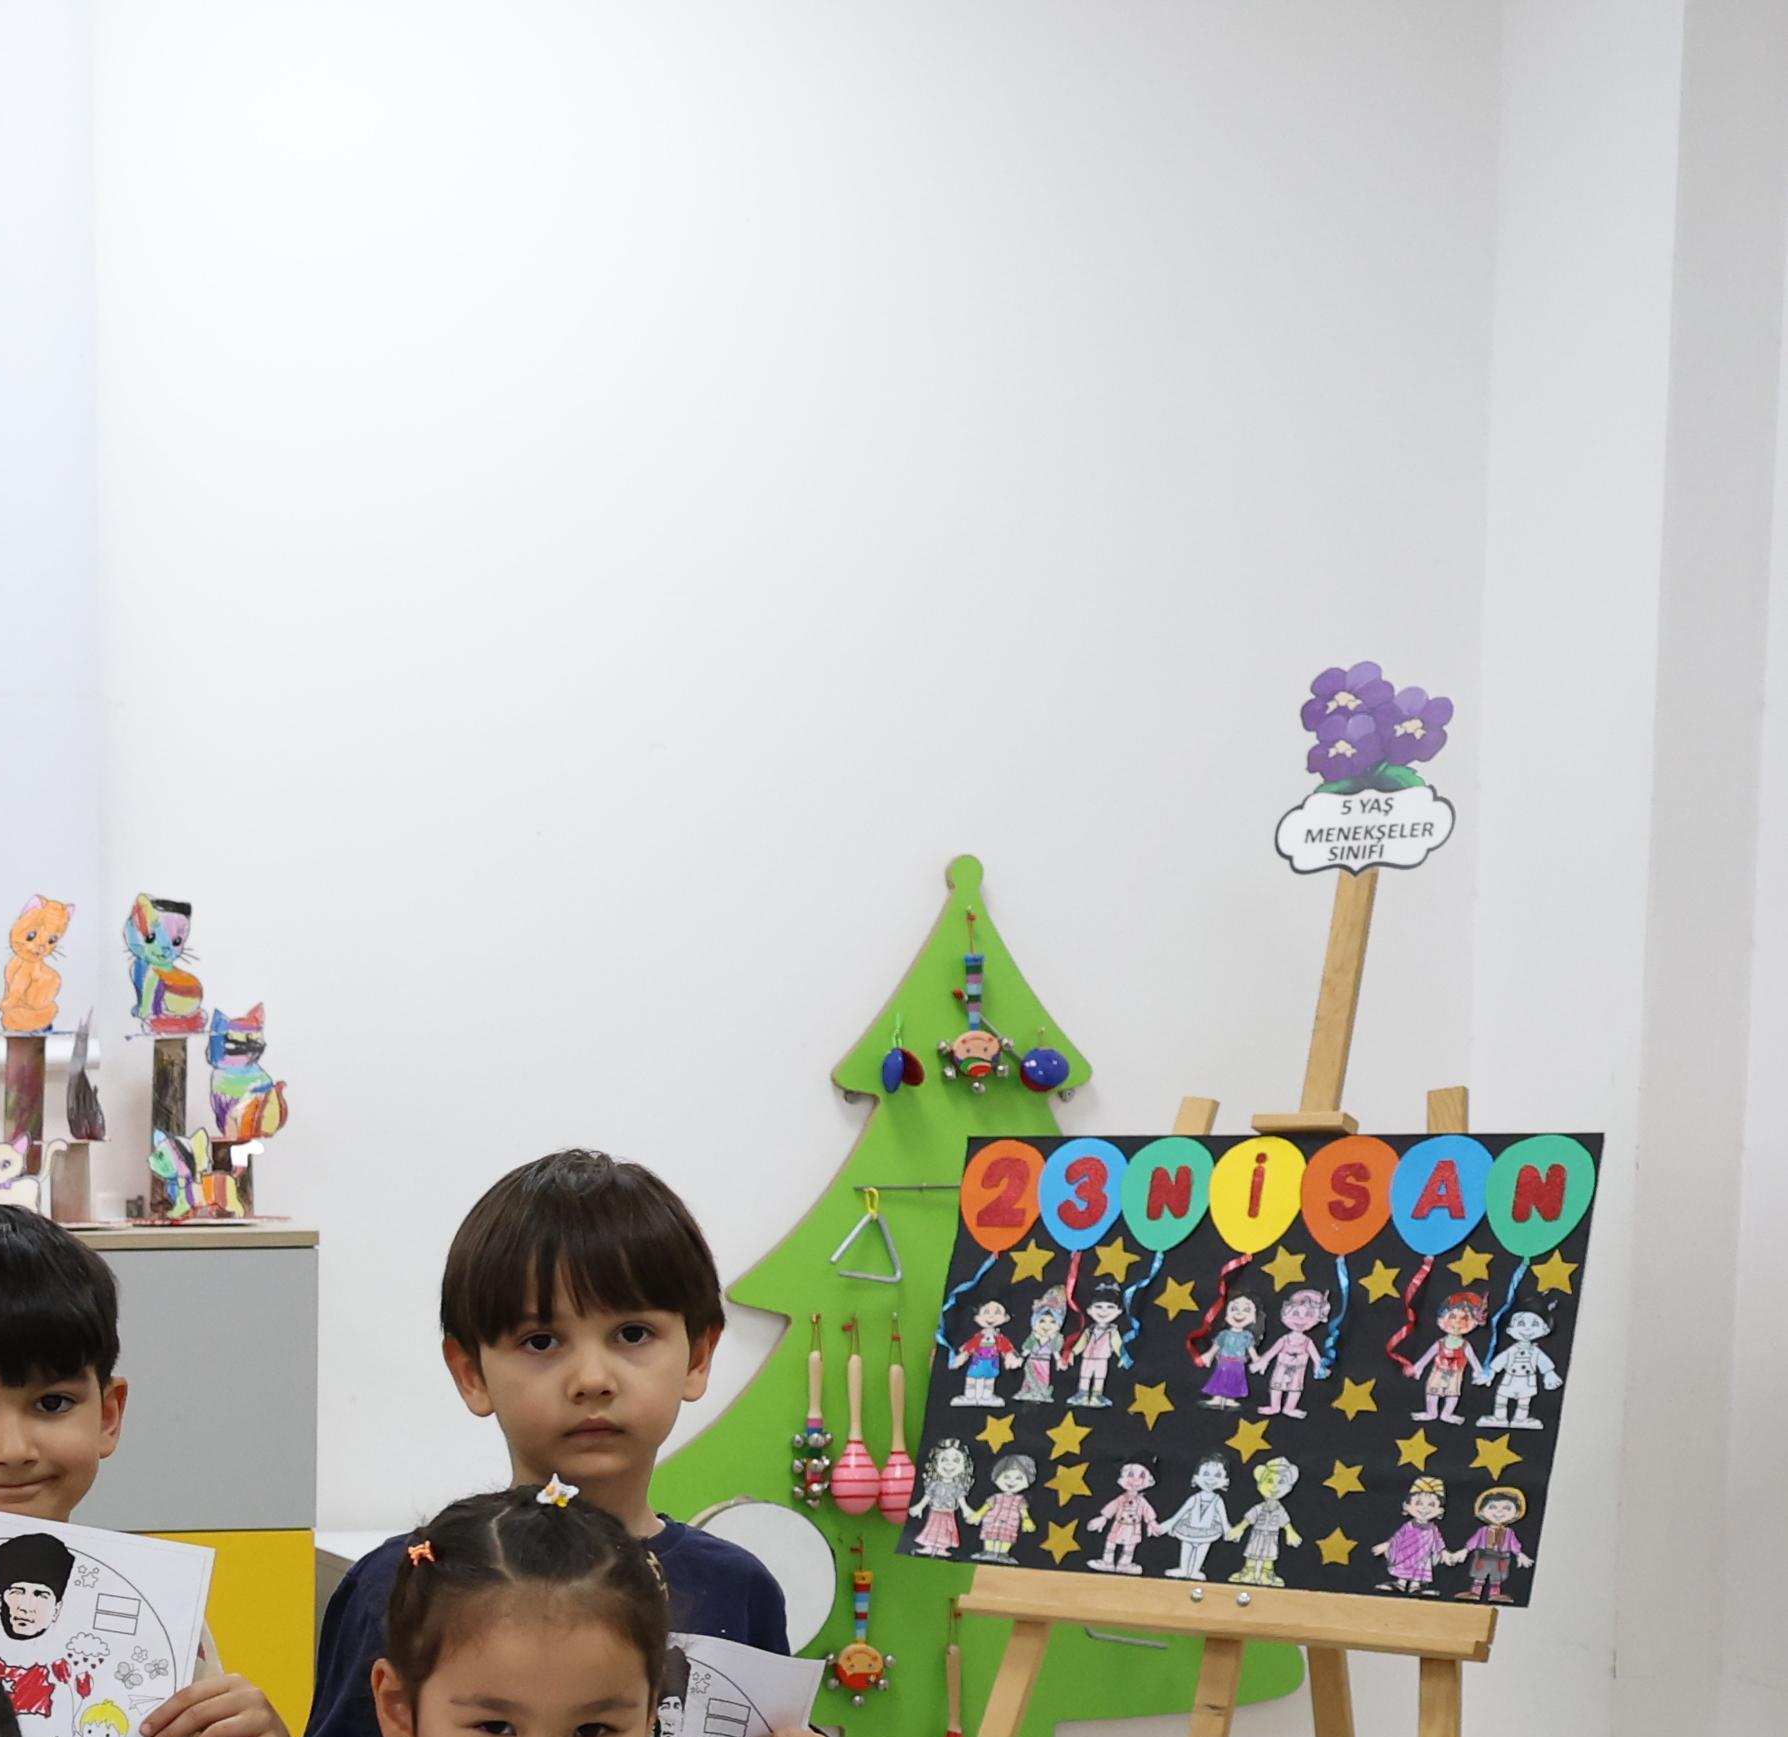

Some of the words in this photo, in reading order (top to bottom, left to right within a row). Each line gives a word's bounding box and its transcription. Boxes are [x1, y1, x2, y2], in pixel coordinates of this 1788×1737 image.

[1341, 800, 1352, 815] 5
[1360, 797, 1394, 816] YAŞ
[1304, 822, 1434, 844] MENEKŞELER
[1328, 844, 1385, 861] SINIFI
[976, 1156, 1108, 1229] 23
